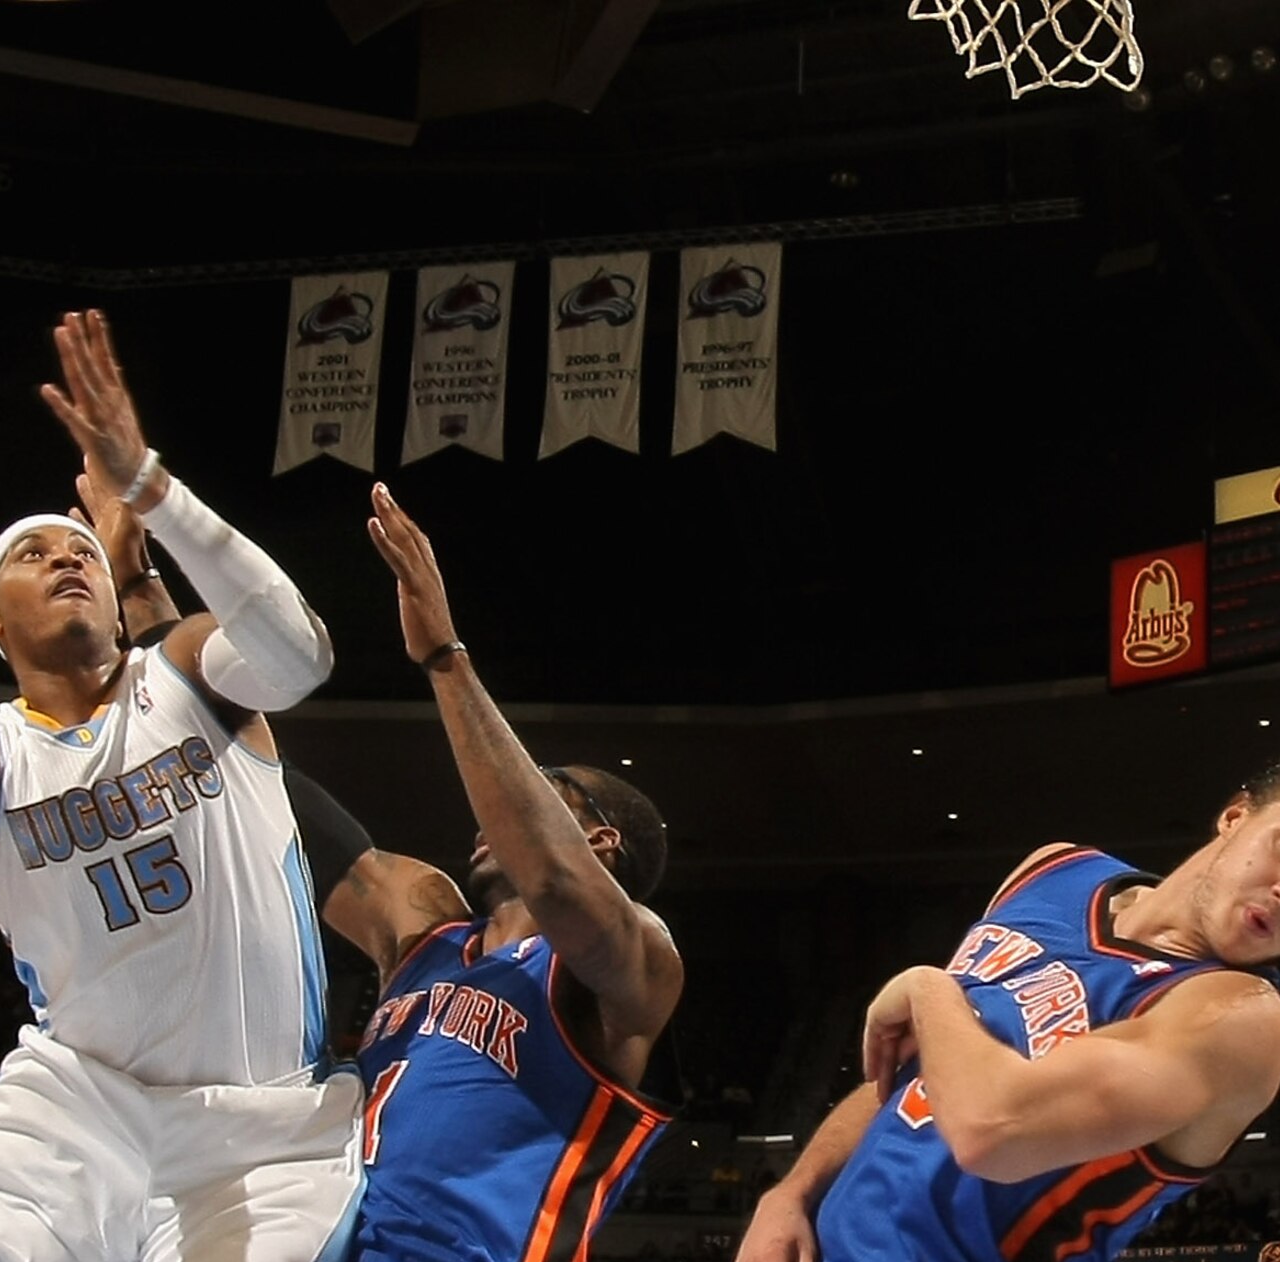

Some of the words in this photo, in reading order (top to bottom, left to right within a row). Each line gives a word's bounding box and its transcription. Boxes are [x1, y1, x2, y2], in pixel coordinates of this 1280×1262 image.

[318, 354, 349, 366] 2001
[422, 358, 494, 374] WESTERN
[297, 369, 366, 382] WESTERN
[413, 373, 501, 391] CONFERENCE
[698, 375, 755, 391] TROPHY
[286, 385, 373, 399] CONFERENCE
[416, 390, 497, 407] CHAMPIONS
[561, 387, 619, 401] TROPHY
[290, 400, 371, 415] CHAMPIONS
[5, 736, 224, 871] NUGGETS
[86, 835, 193, 932] 15
[946, 923, 1045, 983] EW
[1002, 960, 1091, 1061] YORK
[418, 981, 529, 1080] YORK
